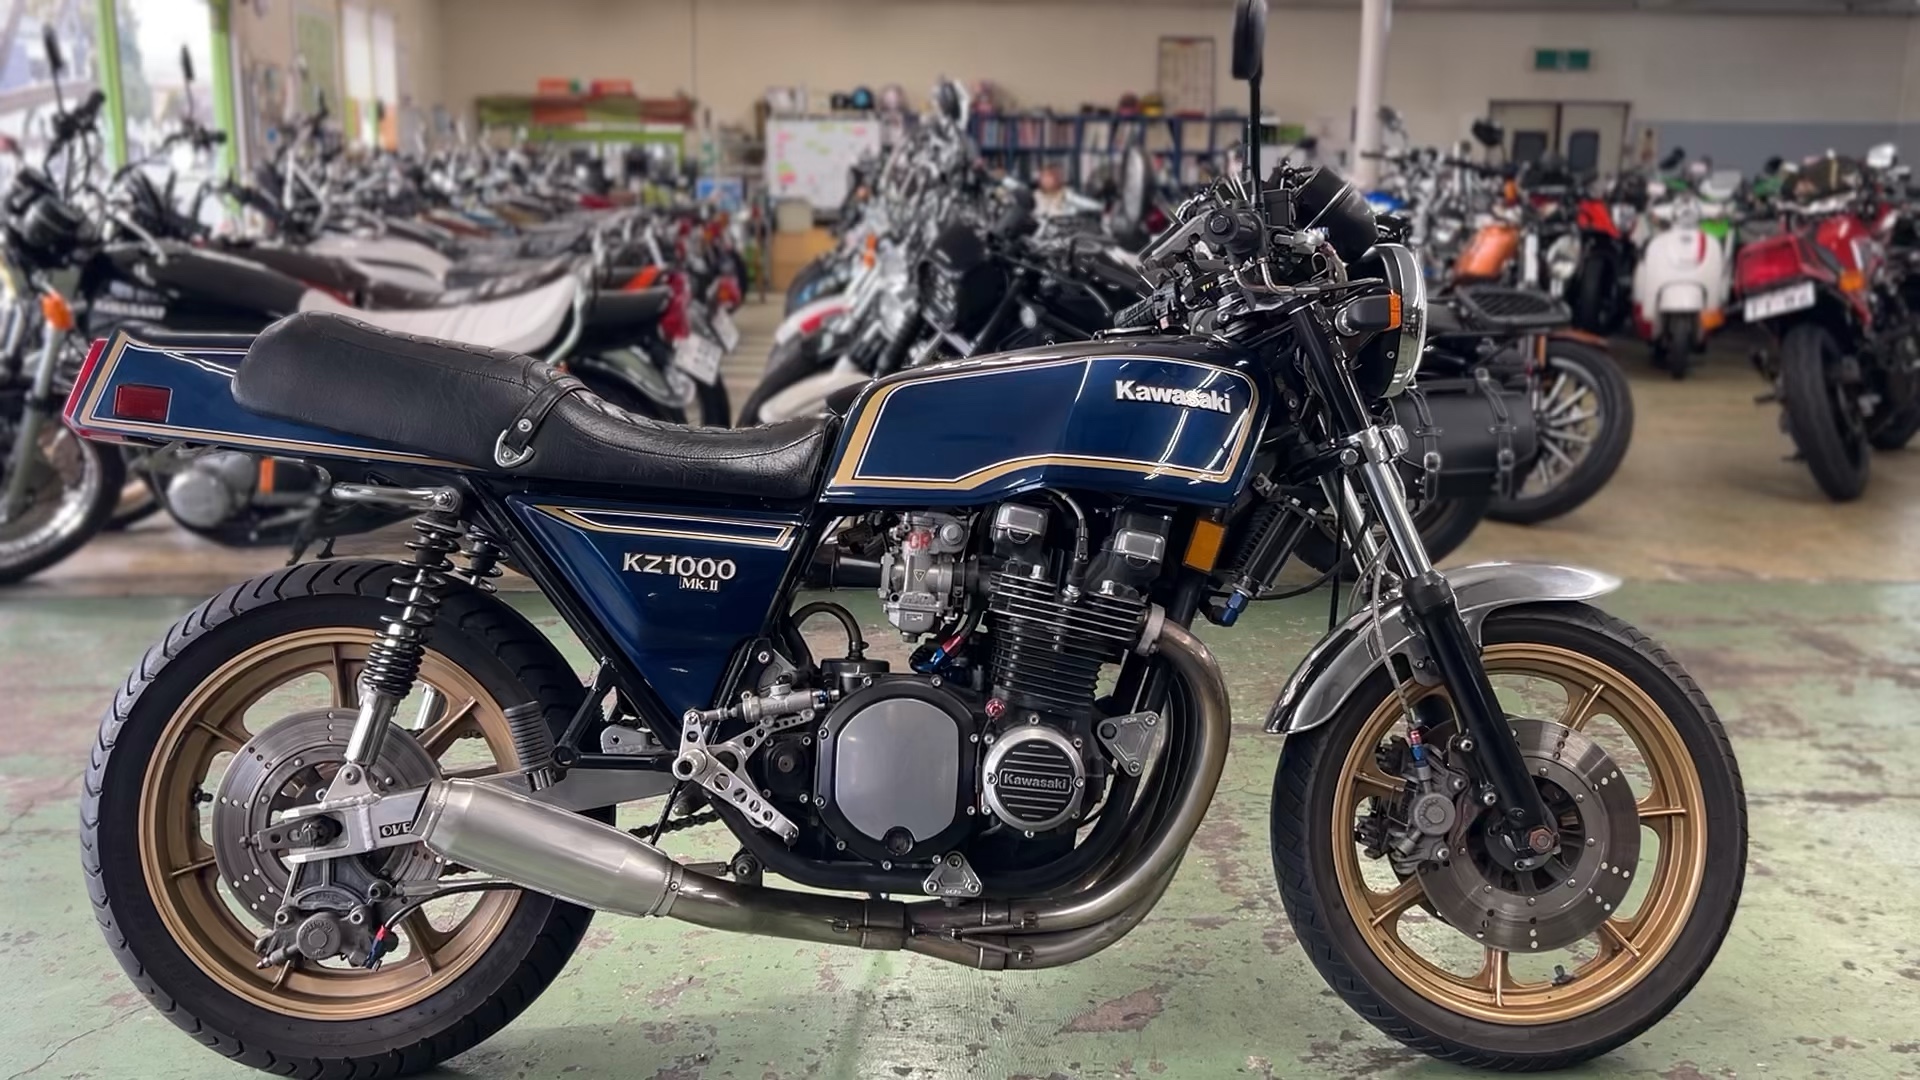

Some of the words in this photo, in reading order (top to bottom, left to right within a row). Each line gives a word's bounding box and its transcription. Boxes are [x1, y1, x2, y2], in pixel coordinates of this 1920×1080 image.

[1115, 380, 1231, 413] Kawasaki
[623, 552, 736, 580] KZ1000
[1004, 773, 1067, 790] Kawasaki
